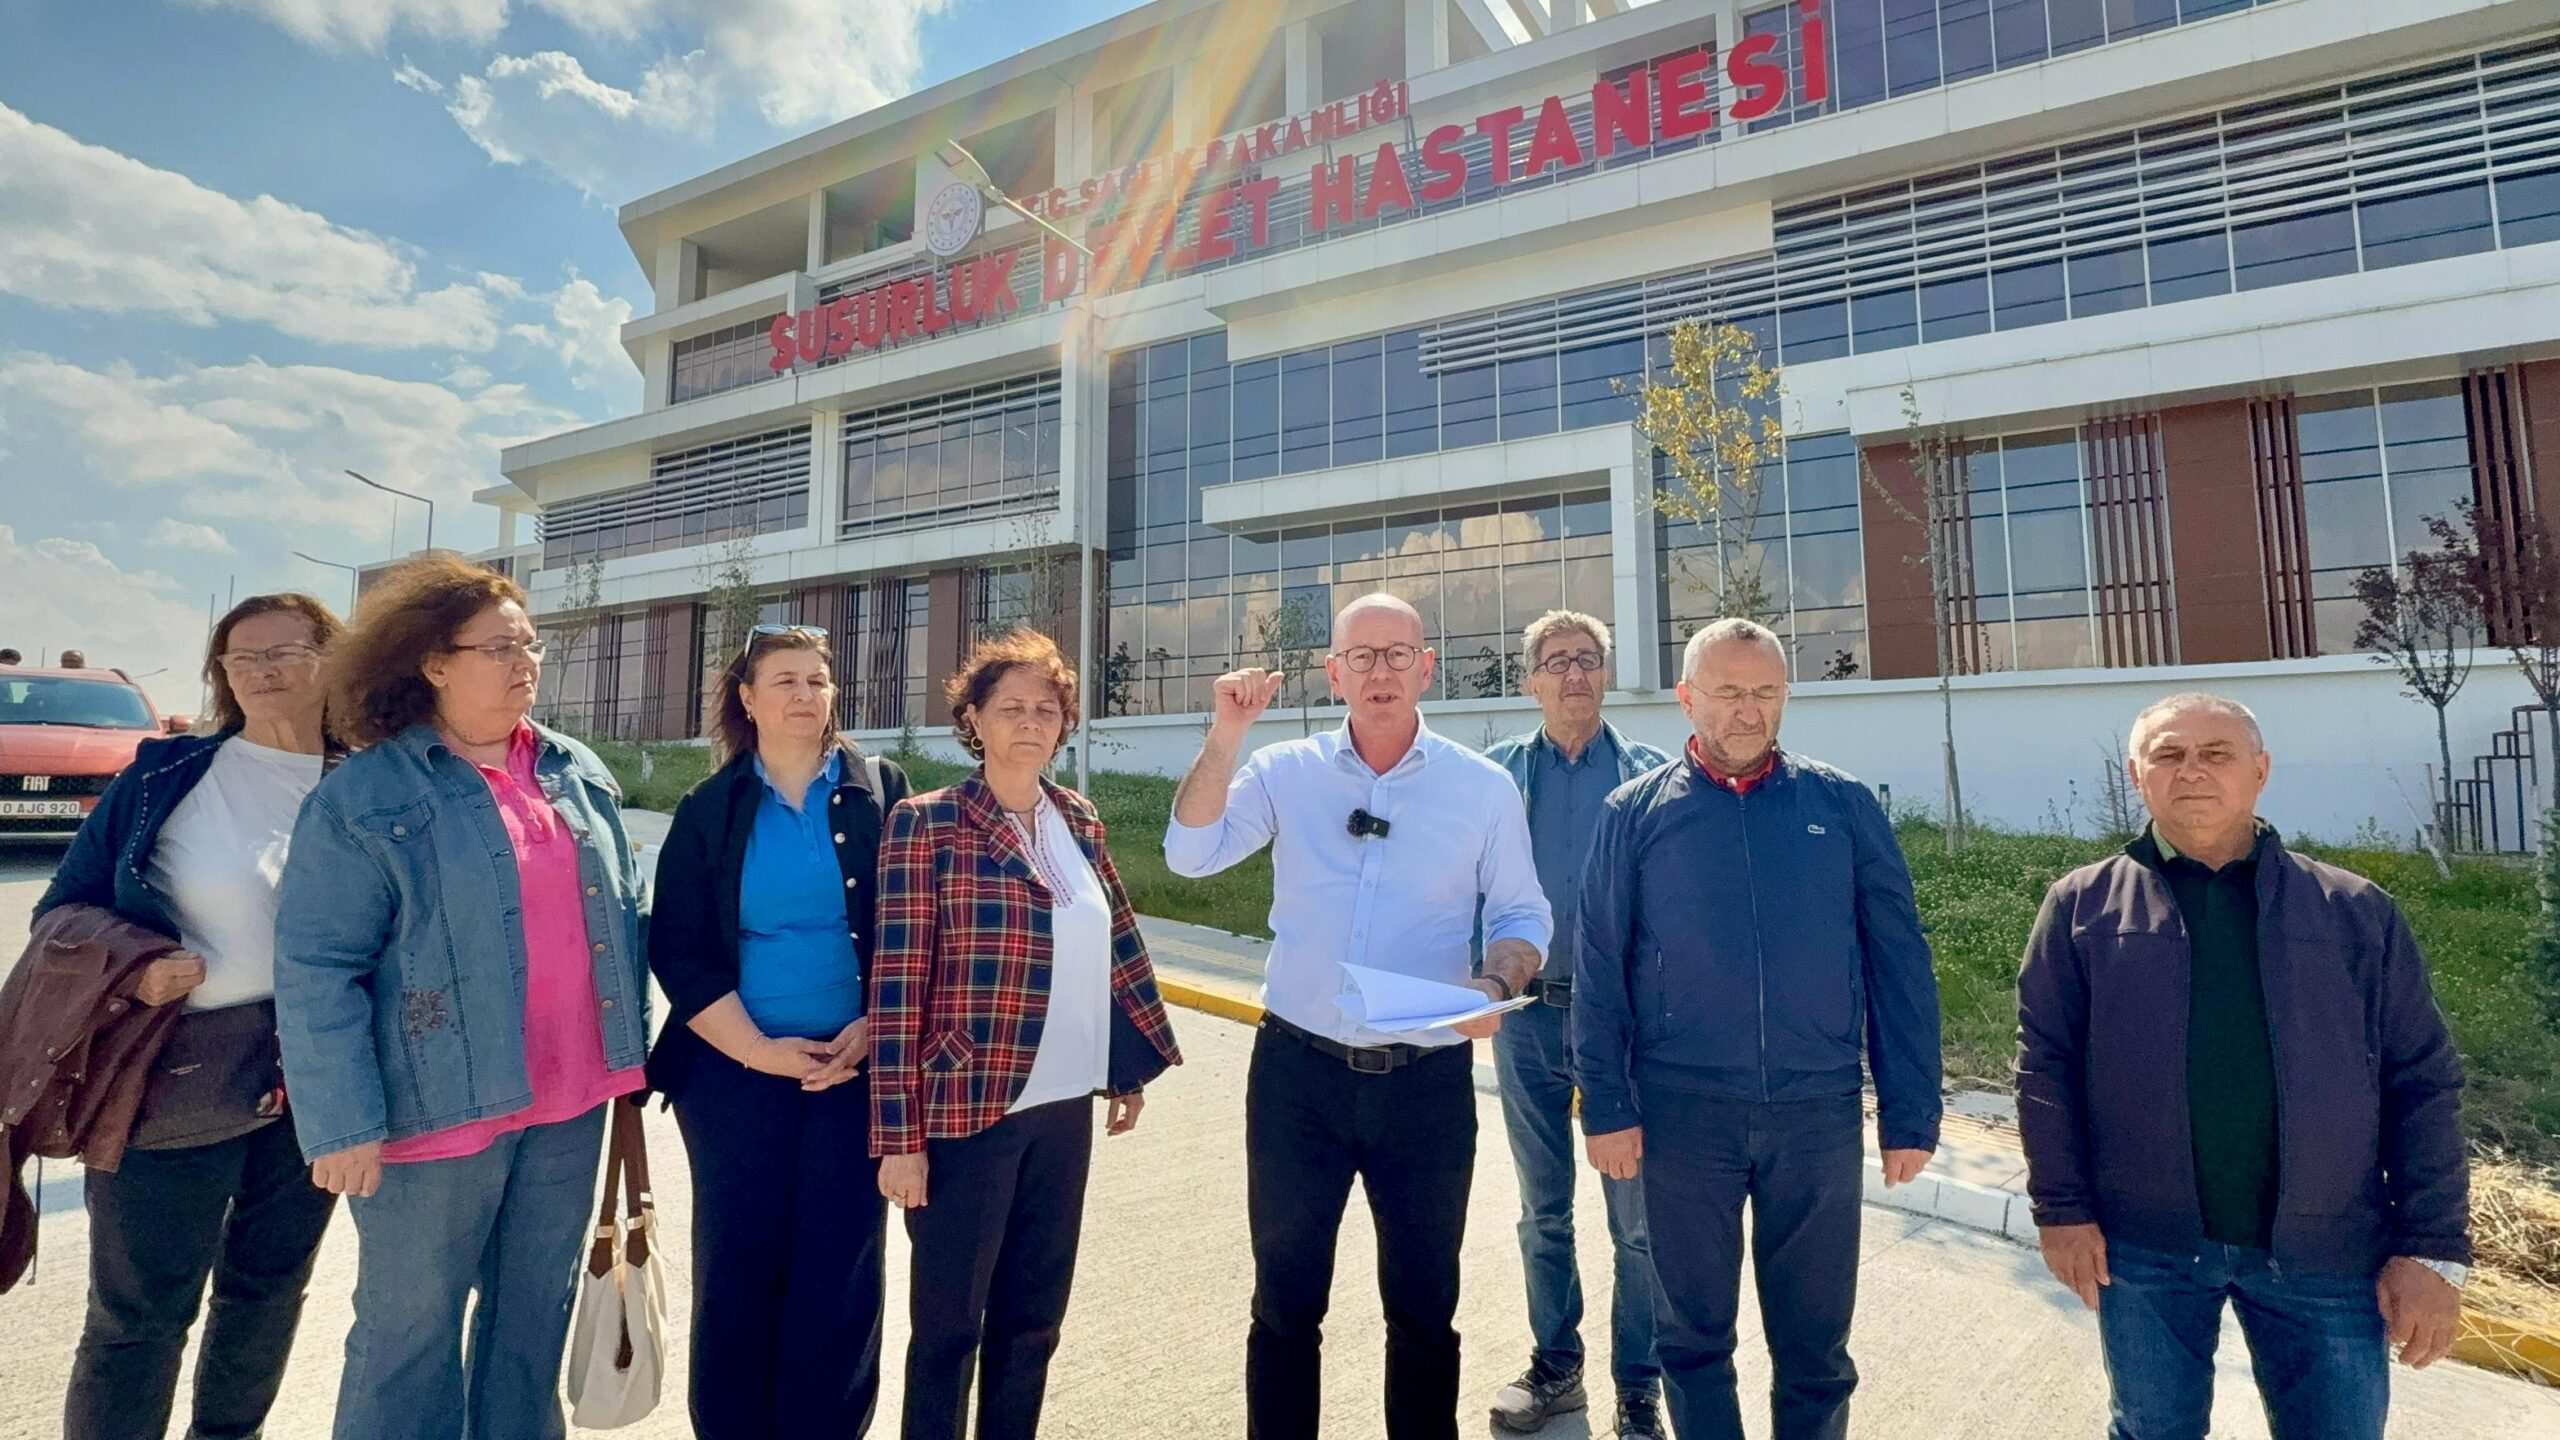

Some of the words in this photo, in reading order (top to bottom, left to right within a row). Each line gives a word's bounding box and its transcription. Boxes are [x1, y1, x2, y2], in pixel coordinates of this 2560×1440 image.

[768, 247, 1020, 371] SUSURLUK
[1311, 0, 1828, 231] HASTANESİ
[23, 775, 51, 791] FIAT
[17, 803, 45, 813] AJG
[49, 803, 77, 813] 920
